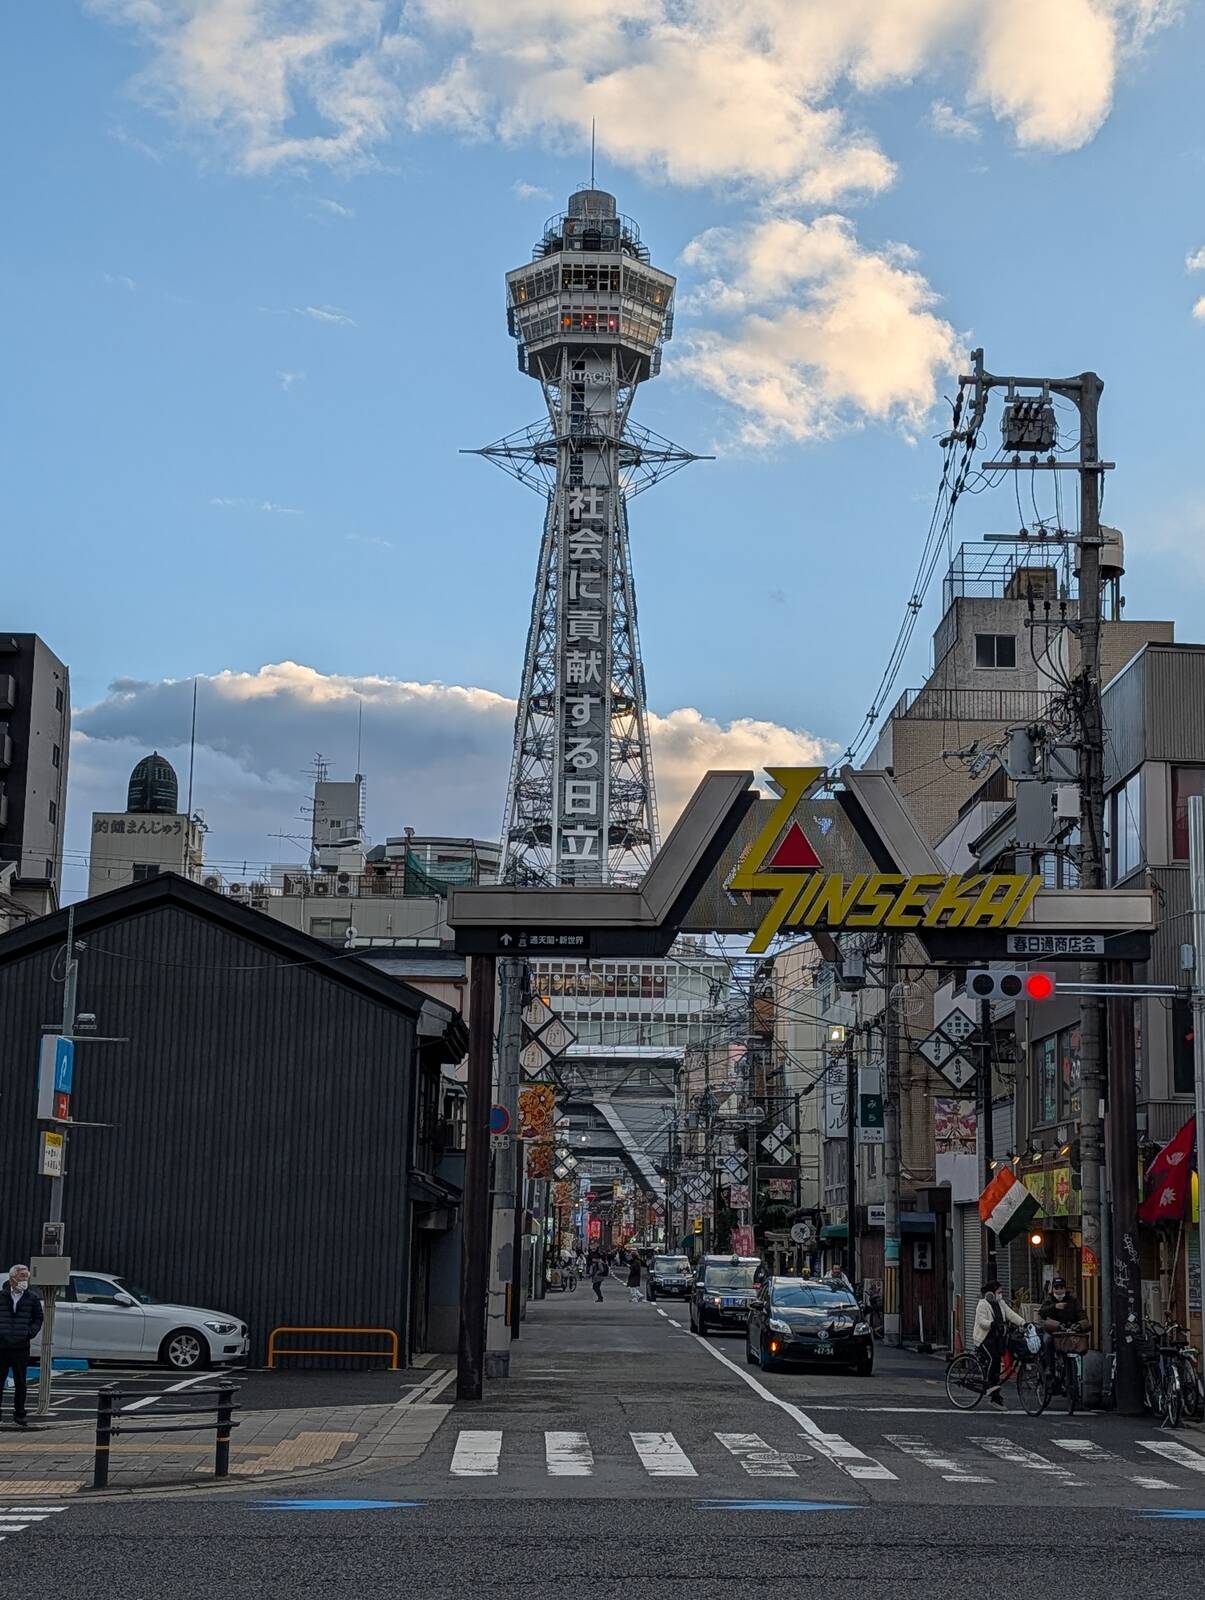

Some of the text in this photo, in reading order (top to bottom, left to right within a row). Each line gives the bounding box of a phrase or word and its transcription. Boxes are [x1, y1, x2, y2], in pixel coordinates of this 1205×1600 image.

[565, 371, 613, 381] HITACH
[561, 487, 603, 861] 社会に貢献する日立
[1013, 936, 1096, 953] 春日通商店会
